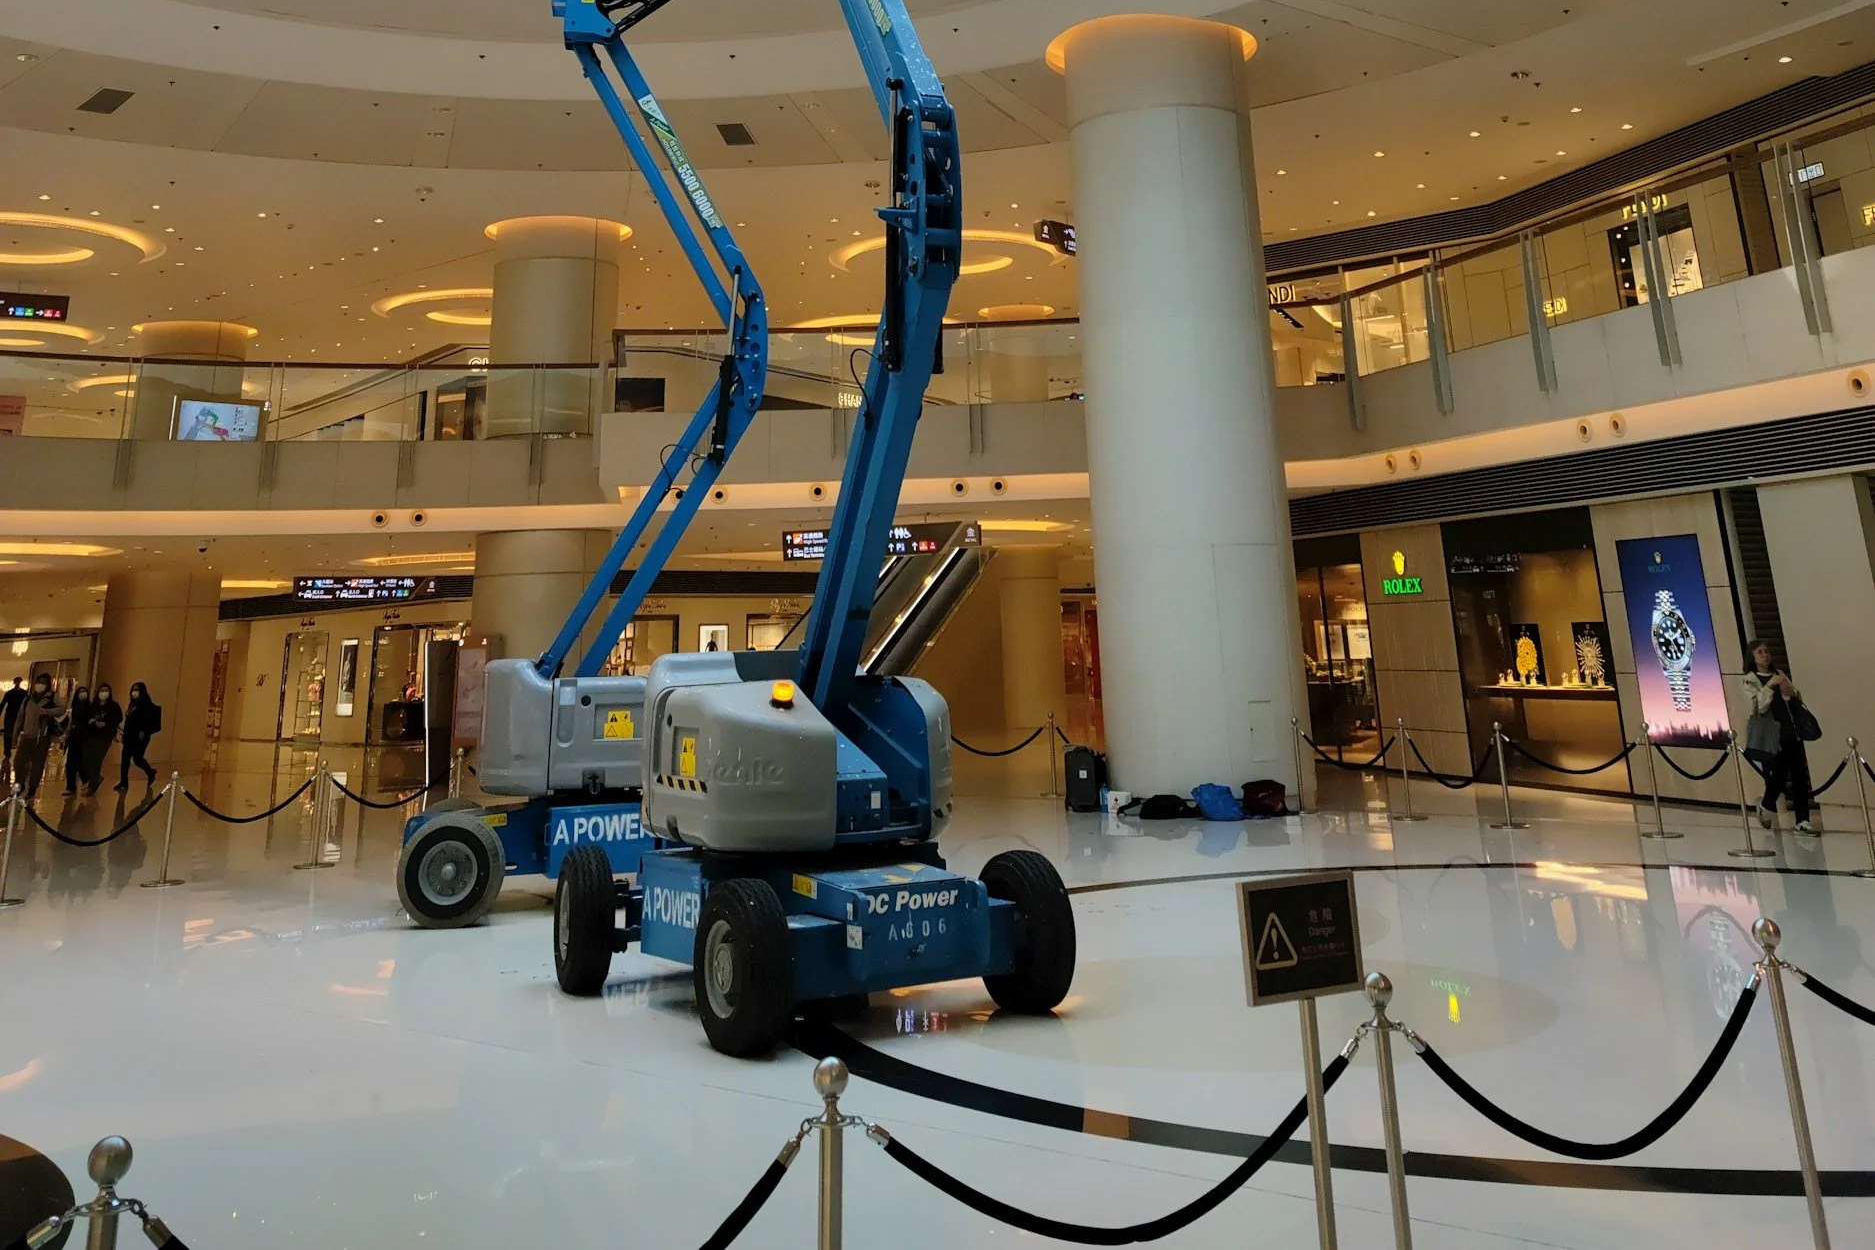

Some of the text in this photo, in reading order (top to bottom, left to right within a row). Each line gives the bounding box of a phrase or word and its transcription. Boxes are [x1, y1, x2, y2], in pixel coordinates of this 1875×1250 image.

[677, 163, 700, 191] 5500
[691, 189, 715, 220] 6000
[1383, 577, 1422, 594] ROLEX
[553, 819, 570, 846] A
[642, 886, 700, 930] A POWER
[895, 889, 959, 912] Power
[1308, 925, 1336, 937] Danger
